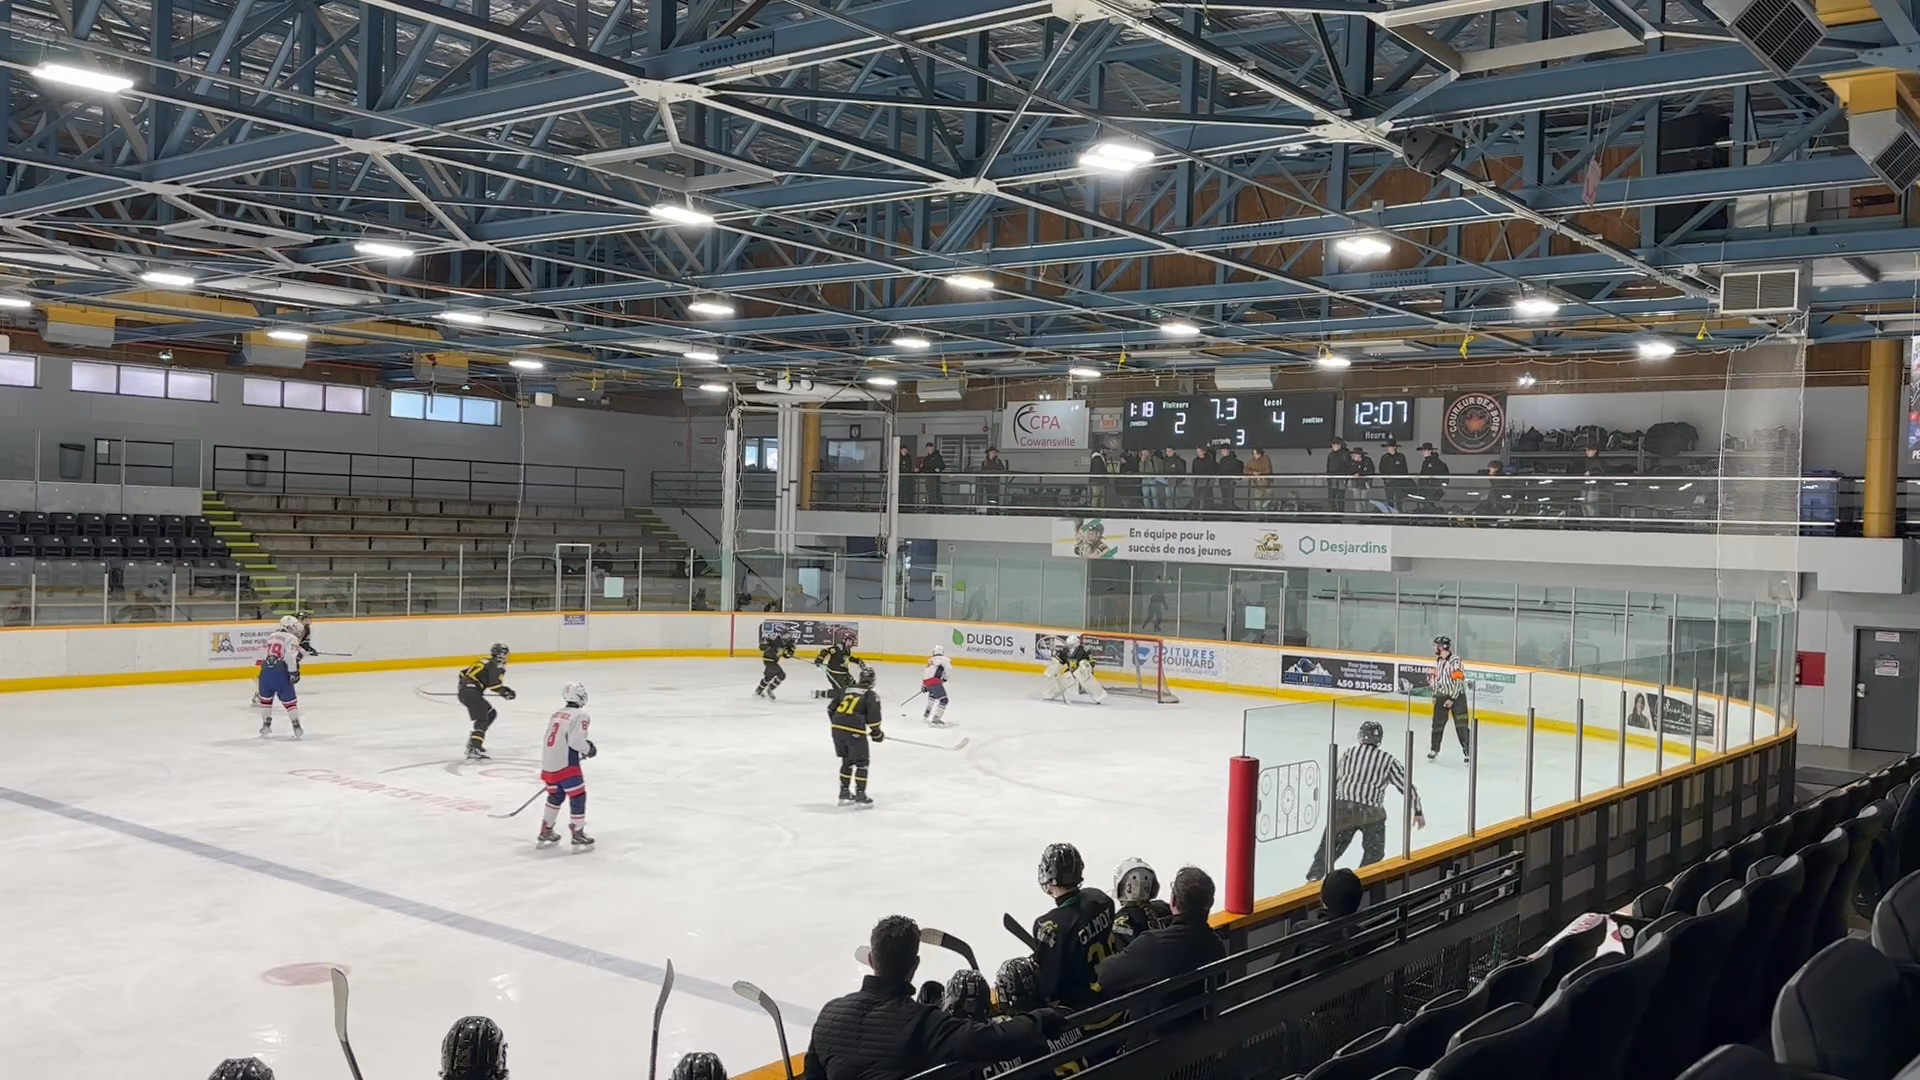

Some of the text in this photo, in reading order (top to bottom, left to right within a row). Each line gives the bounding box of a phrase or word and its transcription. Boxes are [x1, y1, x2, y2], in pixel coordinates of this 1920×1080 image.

[1209, 398, 1238, 420] 7.3
[1263, 398, 1284, 408] Local
[1355, 401, 1408, 425] 12:07
[1449, 397, 1500, 433] COUREUR DES BOIS
[1030, 415, 1061, 431] CPA
[1174, 412, 1187, 434] 2
[1272, 411, 1285, 432] 4
[1020, 436, 1077, 448] Cowansville
[1236, 429, 1246, 447] 3
[1365, 431, 1387, 440] Heure
[1129, 528, 1217, 543] En équipe pour le
[1128, 543, 1233, 558] succès de nos jeunes
[1320, 539, 1388, 556] Desjardins
[967, 633, 1014, 648] DUBOIS
[966, 646, 1014, 656] Aménagement
[1153, 645, 1215, 660] TOITURES
[1338, 679, 1354, 687] 450
[1355, 682, 1393, 692] 931-0225
[837, 694, 861, 715] 51
[581, 720, 589, 731] 8
[547, 722, 560, 747] 8
